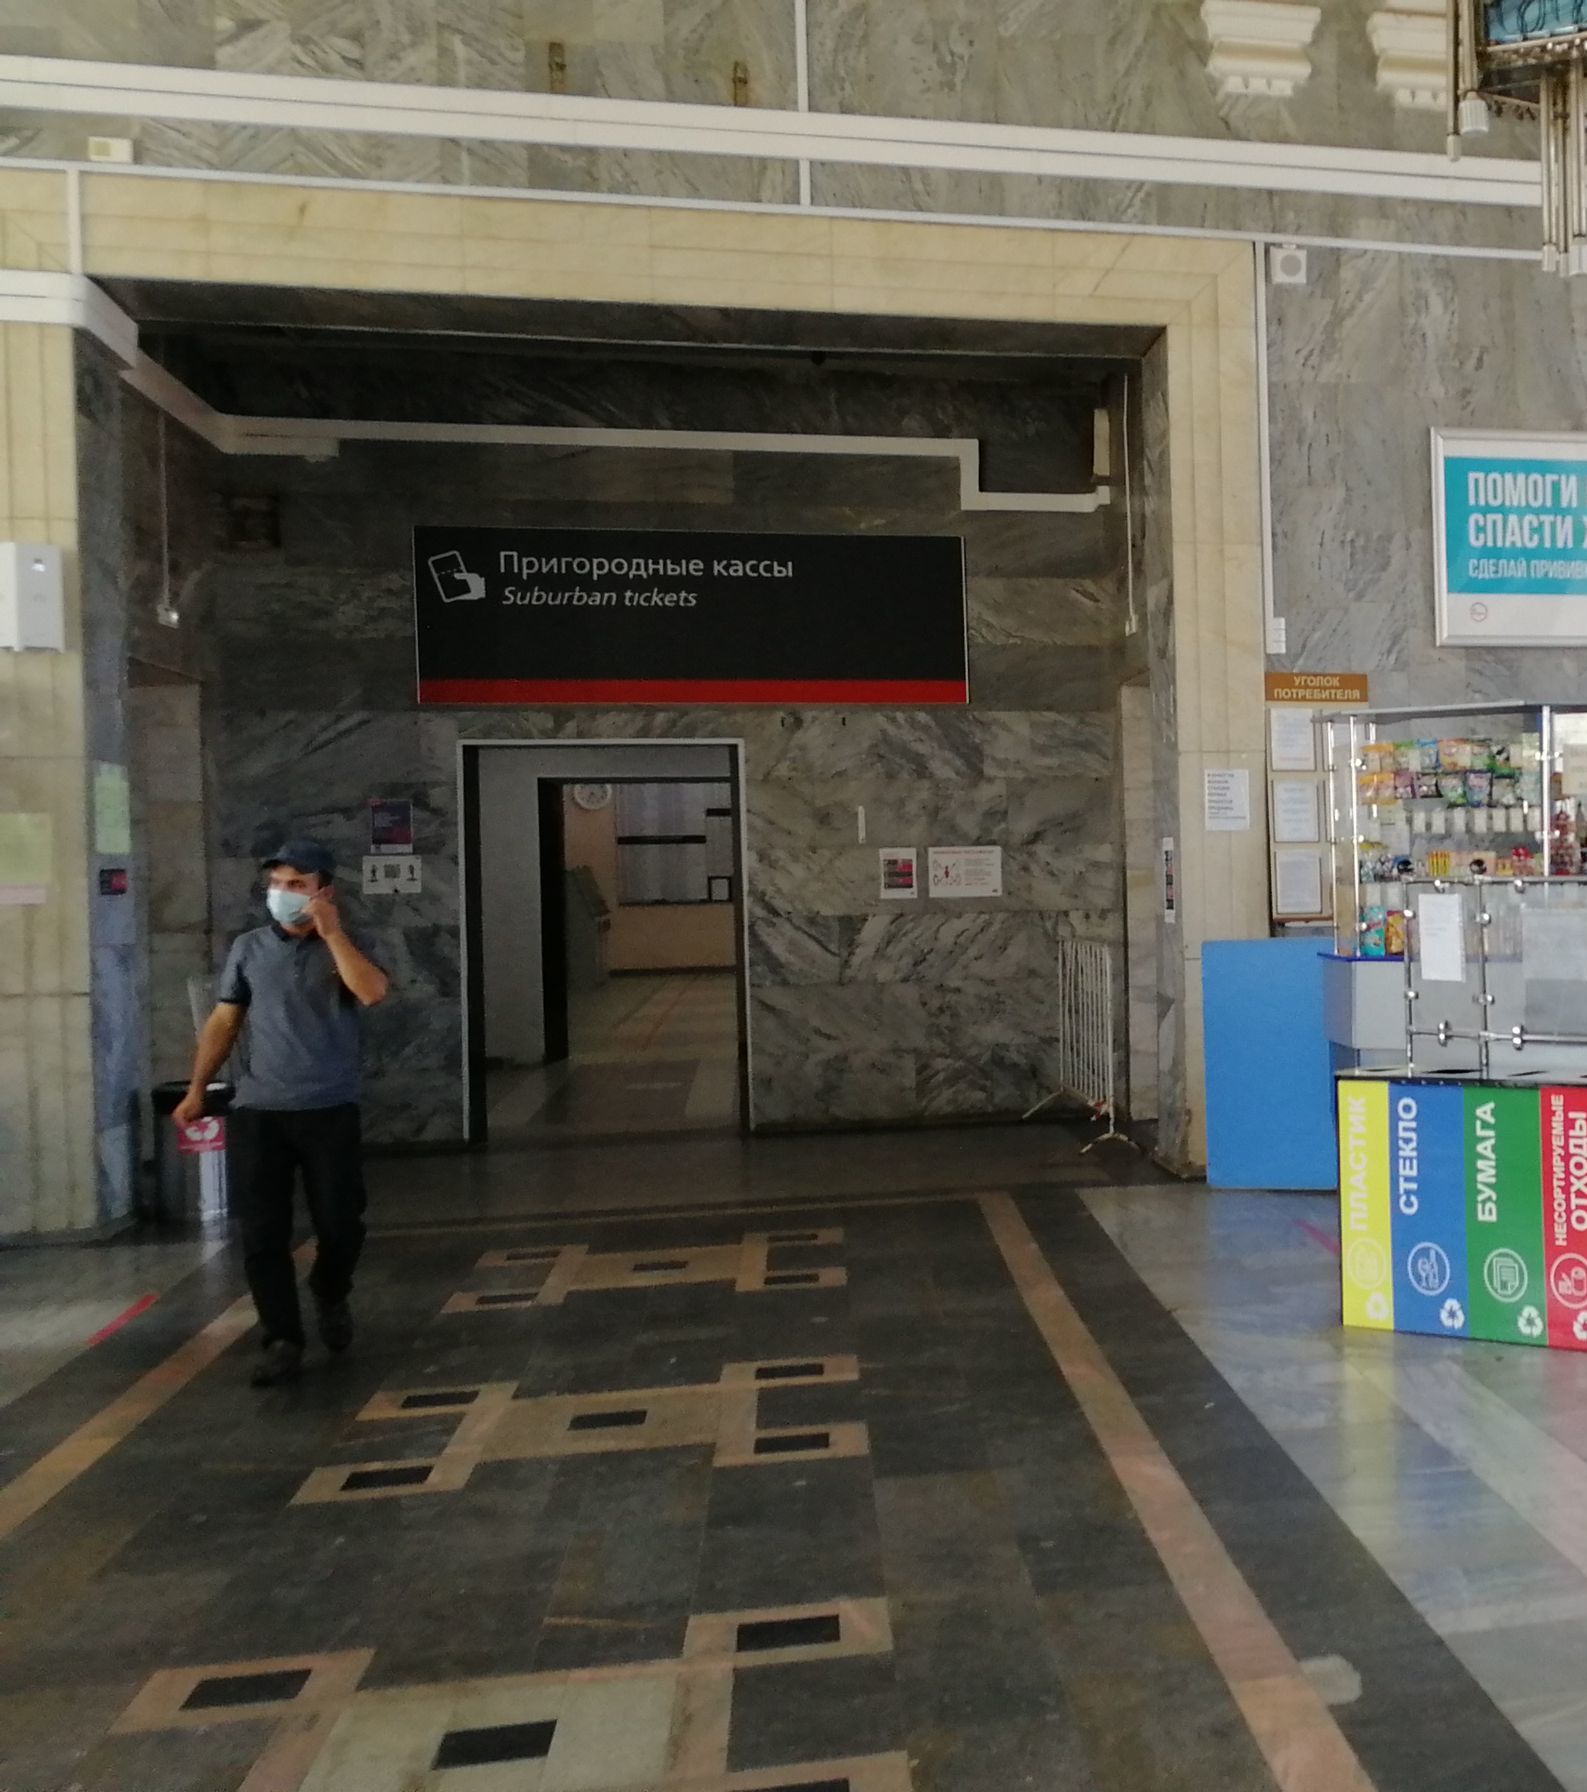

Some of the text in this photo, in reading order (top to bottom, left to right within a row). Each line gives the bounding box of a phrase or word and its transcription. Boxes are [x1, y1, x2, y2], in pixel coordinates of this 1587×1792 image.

[1467, 471, 1578, 508] ПОМОГИ
[1468, 513, 1573, 549] СПАСТИ
[500, 551, 794, 579] Пригородные кассы
[1468, 557, 1527, 580] СДЕЛАЙ
[502, 587, 698, 608] Suburban tickets
[1273, 688, 1361, 700] ПОТРЕБИТЕЛЯ
[1293, 676, 1341, 688] УГОЛОК
[1346, 1095, 1369, 1232] ПЛАСТИК
[1397, 1096, 1420, 1216] СТЕКЛО
[1475, 1101, 1498, 1223] БУМАГА
[1550, 1094, 1568, 1247] НЕСОРТИРУЕМЫЕ
